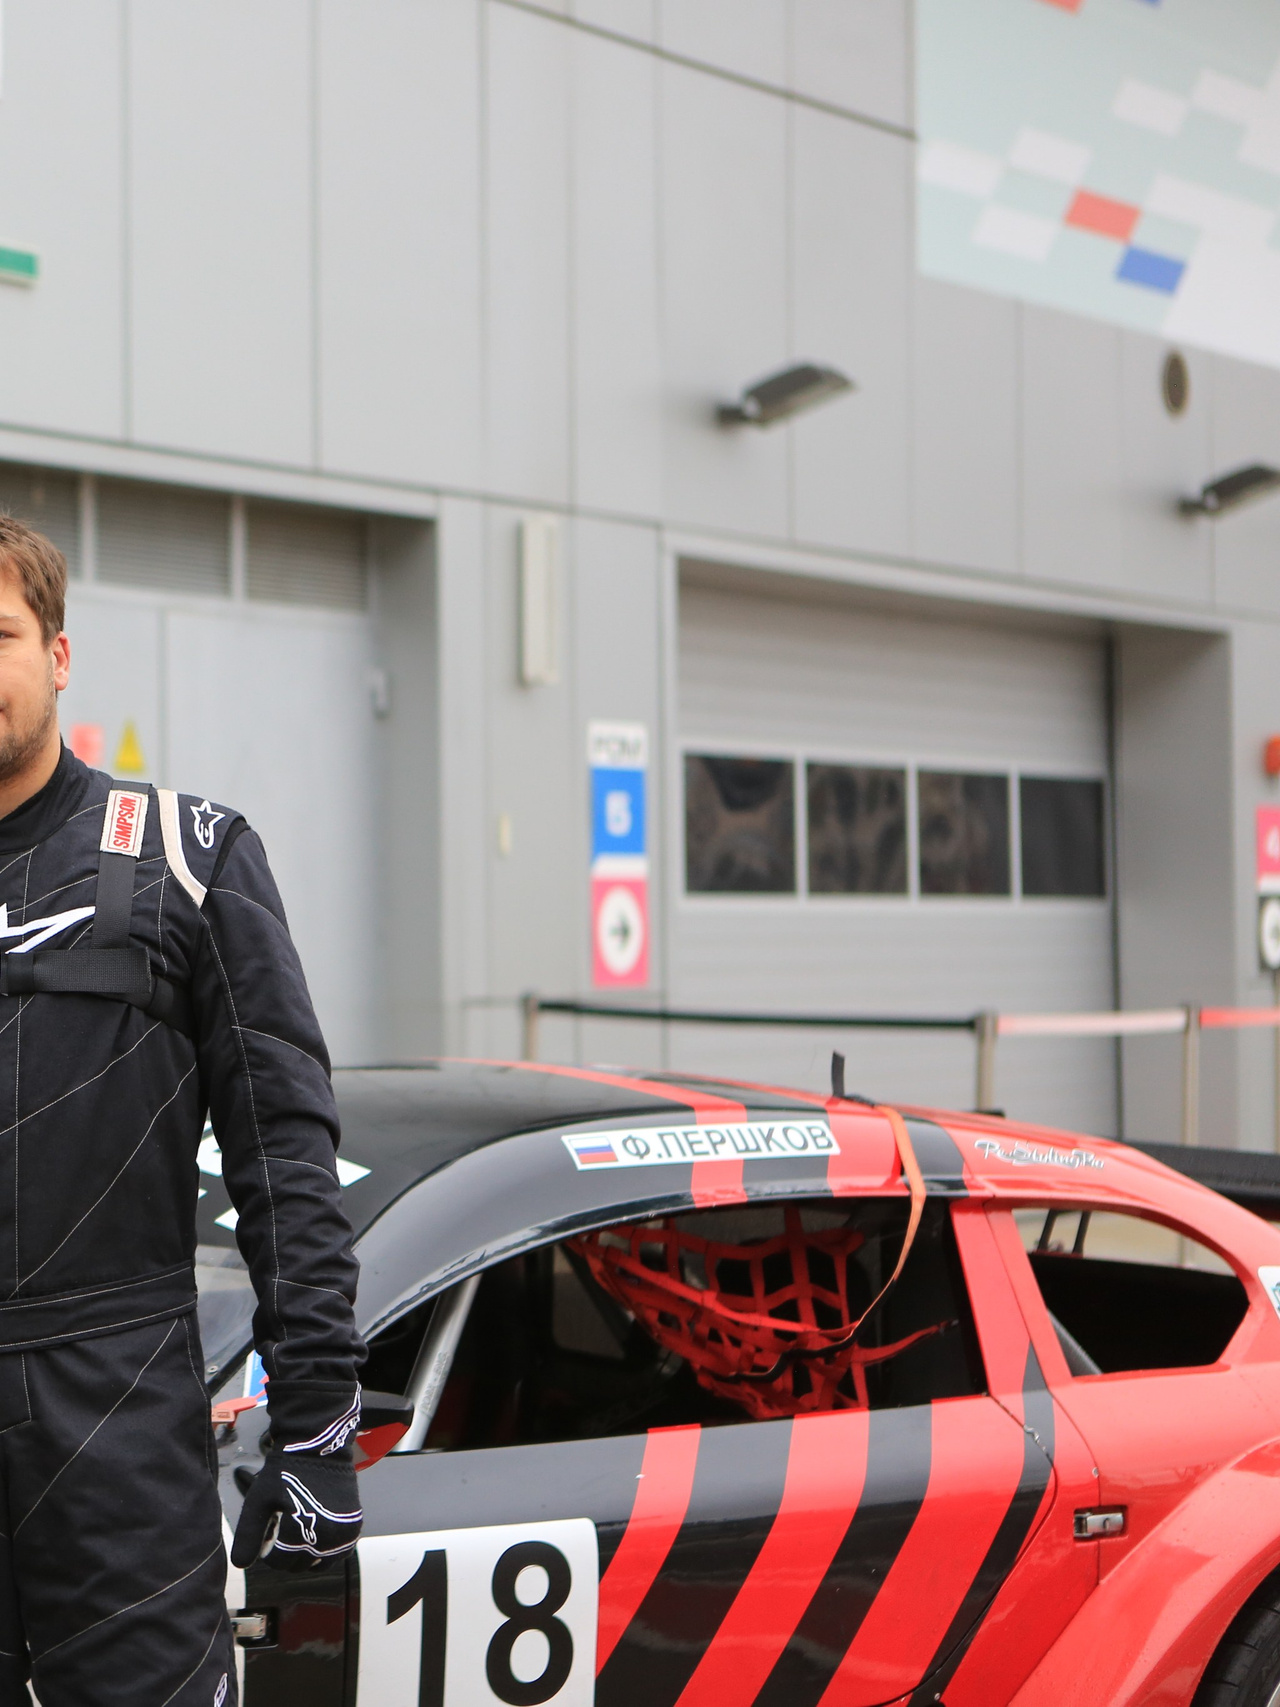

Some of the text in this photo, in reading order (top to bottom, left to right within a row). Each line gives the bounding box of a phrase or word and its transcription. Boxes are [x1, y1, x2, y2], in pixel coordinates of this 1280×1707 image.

[113, 796, 136, 849] SIMPSON
[621, 1126, 834, 1160] Ф.ПЕРШКОВ
[387, 1540, 574, 1707] 18
